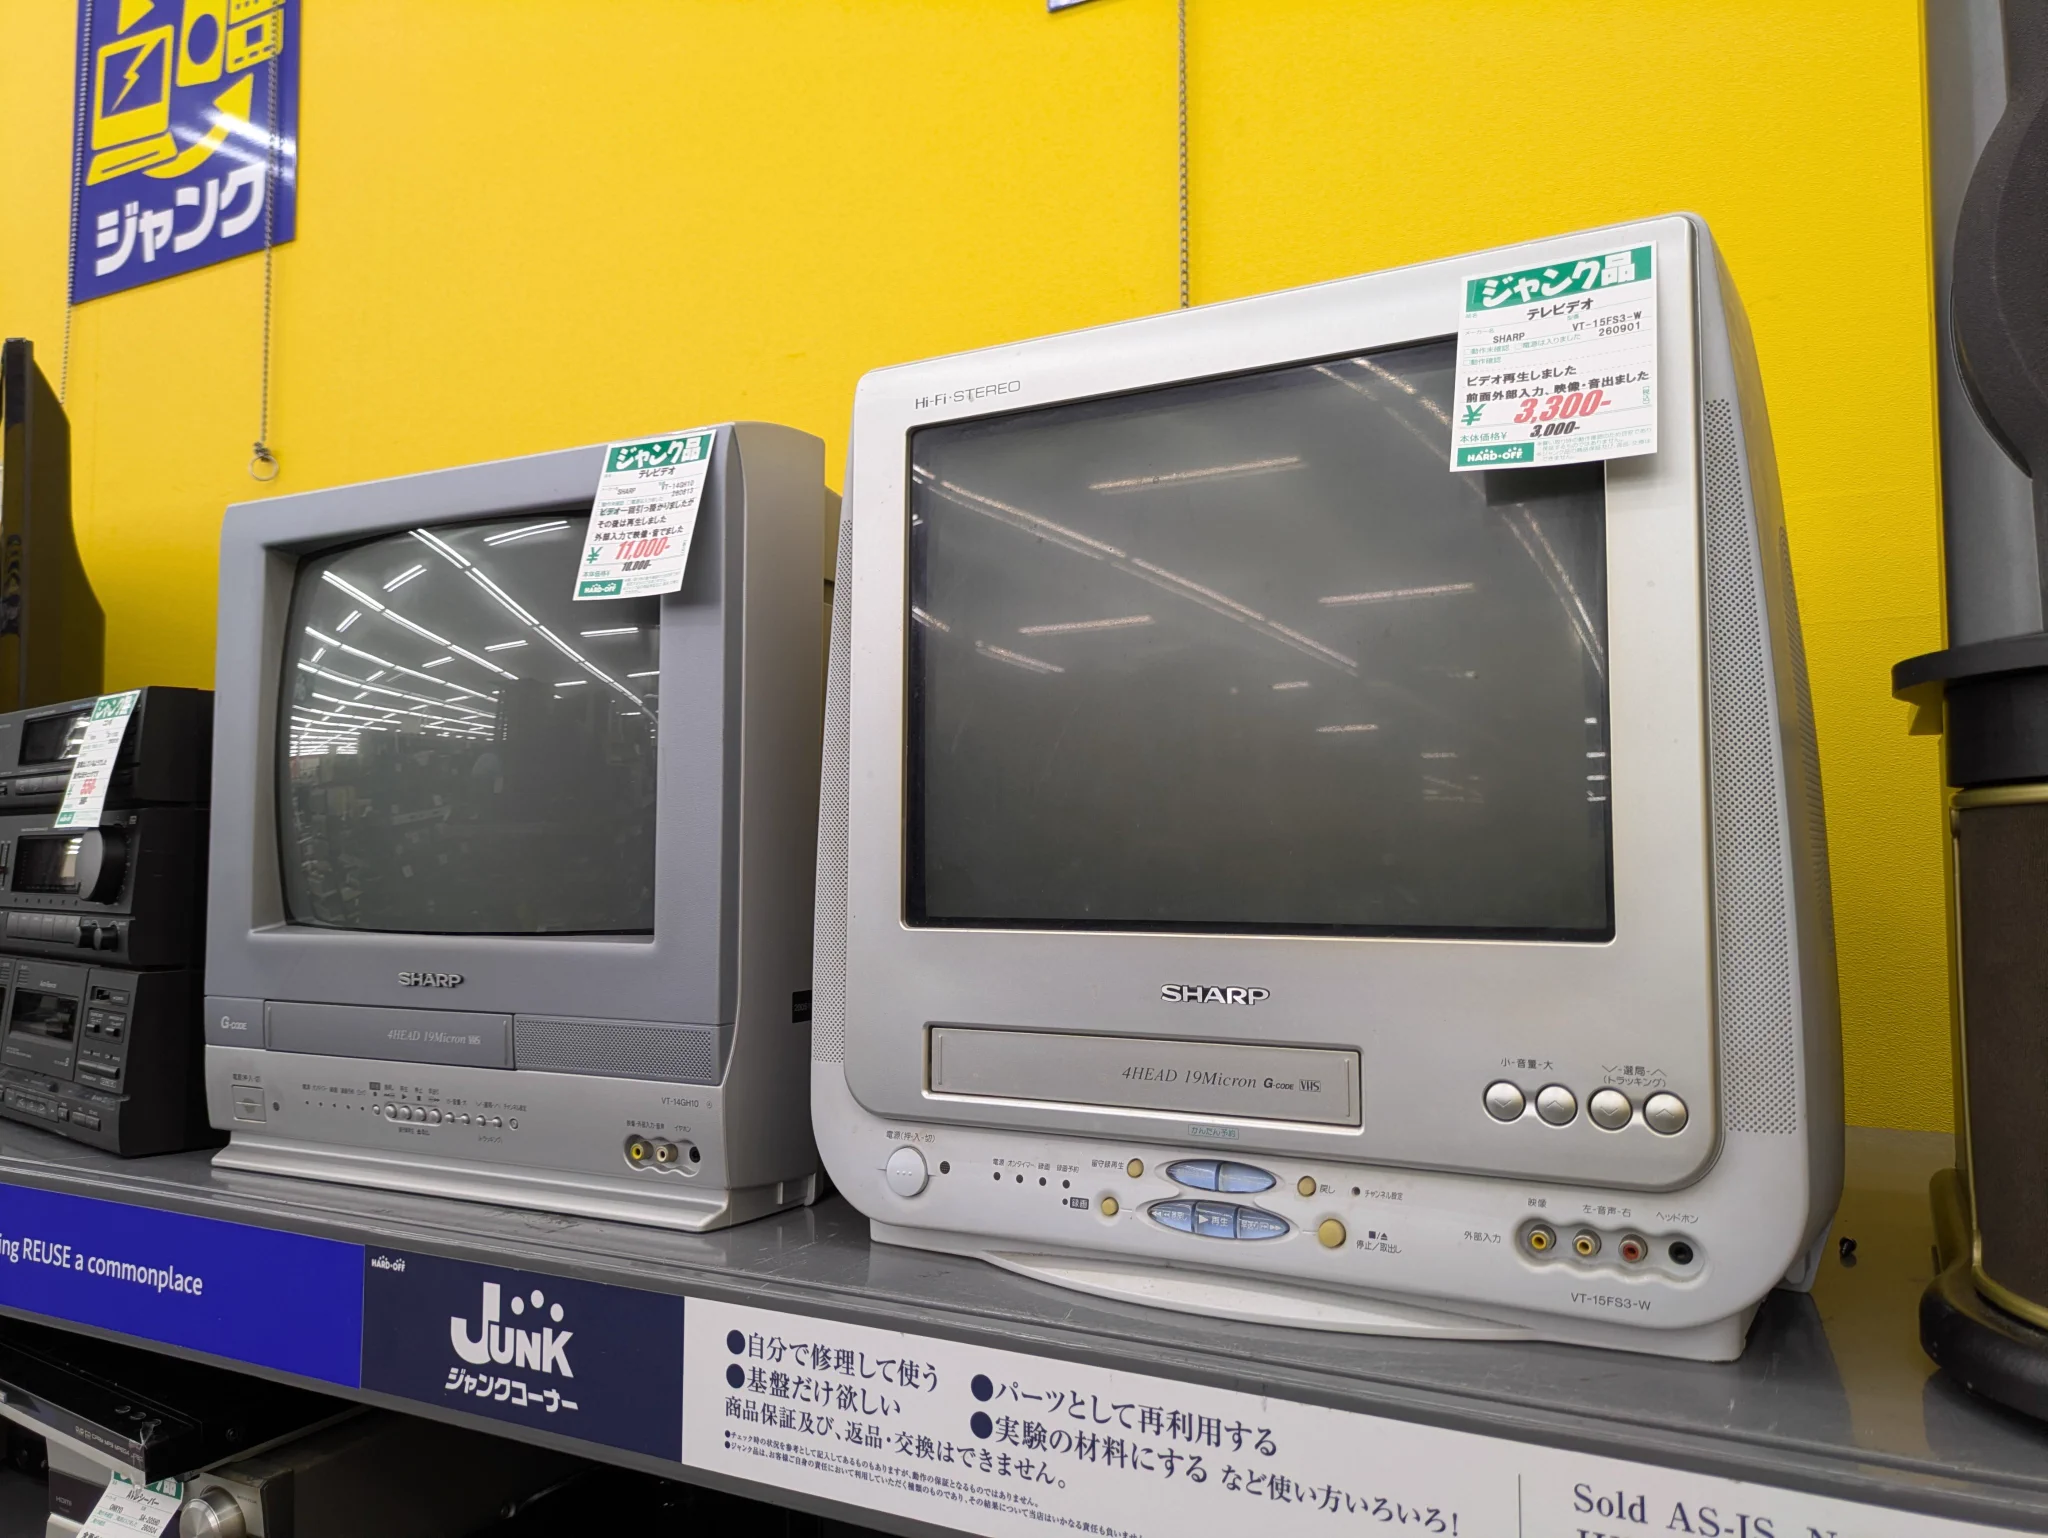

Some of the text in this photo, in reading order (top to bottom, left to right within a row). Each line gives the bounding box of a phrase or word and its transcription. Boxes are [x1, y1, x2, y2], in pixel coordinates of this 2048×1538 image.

[95, 161, 266, 276] ジャンク
[1482, 250, 1635, 308] ジャンク品
[1526, 298, 1594, 321] テレビデオ
[1572, 311, 1643, 332] VT-15FS3-W
[1598, 321, 1641, 337] 260901
[1492, 332, 1526, 344] SHARP
[1466, 370, 1649, 404] 前面外部入力、映像・音出ました
[1467, 365, 1577, 387] ビデオ再生しました
[1513, 389, 1612, 424] 3,300-
[1529, 421, 1580, 438] 3,000-
[616, 436, 701, 470] ジャンク品
[638, 467, 675, 478] テレビデオ
[597, 515, 667, 529] その後は再生しました
[615, 536, 671, 561] 11,000-
[398, 971, 464, 988] SHARP
[1161, 984, 1270, 1005] SHARP
[387, 1029, 421, 1041] 4HEAD
[423, 1031, 466, 1044] 19Micron
[1121, 1066, 1321, 1092] 4HEAD 19Micron G-CODE VHS
[661, 1097, 699, 1108] VT-14GH10
[1191, 1125, 1236, 1138] かんたん予約
[1091, 1158, 1124, 1170] 留守録再生
[1365, 1190, 1403, 1200] チャンネル設定
[1527, 1198, 1547, 1208] 映像
[1655, 1211, 1699, 1224] ヘッドホン
[1463, 1231, 1501, 1244] 外部入力
[22, 1237, 72, 1268] REUSE
[75, 1254, 84, 1271] a
[87, 1256, 204, 1295] commonplace
[1570, 1292, 1652, 1311] VT-15FS3-W
[450, 1281, 574, 1378] JUNK
[747, 1332, 938, 1393] 自分で修理して使う
[445, 1367, 579, 1413] ジャンクコーナー
[746, 1366, 901, 1417] 基盤だけ欲しい
[995, 1382, 1277, 1457] パーツとして再利用する
[724, 1395, 1066, 1489] 商品保証及び、返品・交換はできません。
[995, 1417, 1208, 1483] 実験の材料にする
[1573, 1482, 1775, 1538] Sold AS-IS
